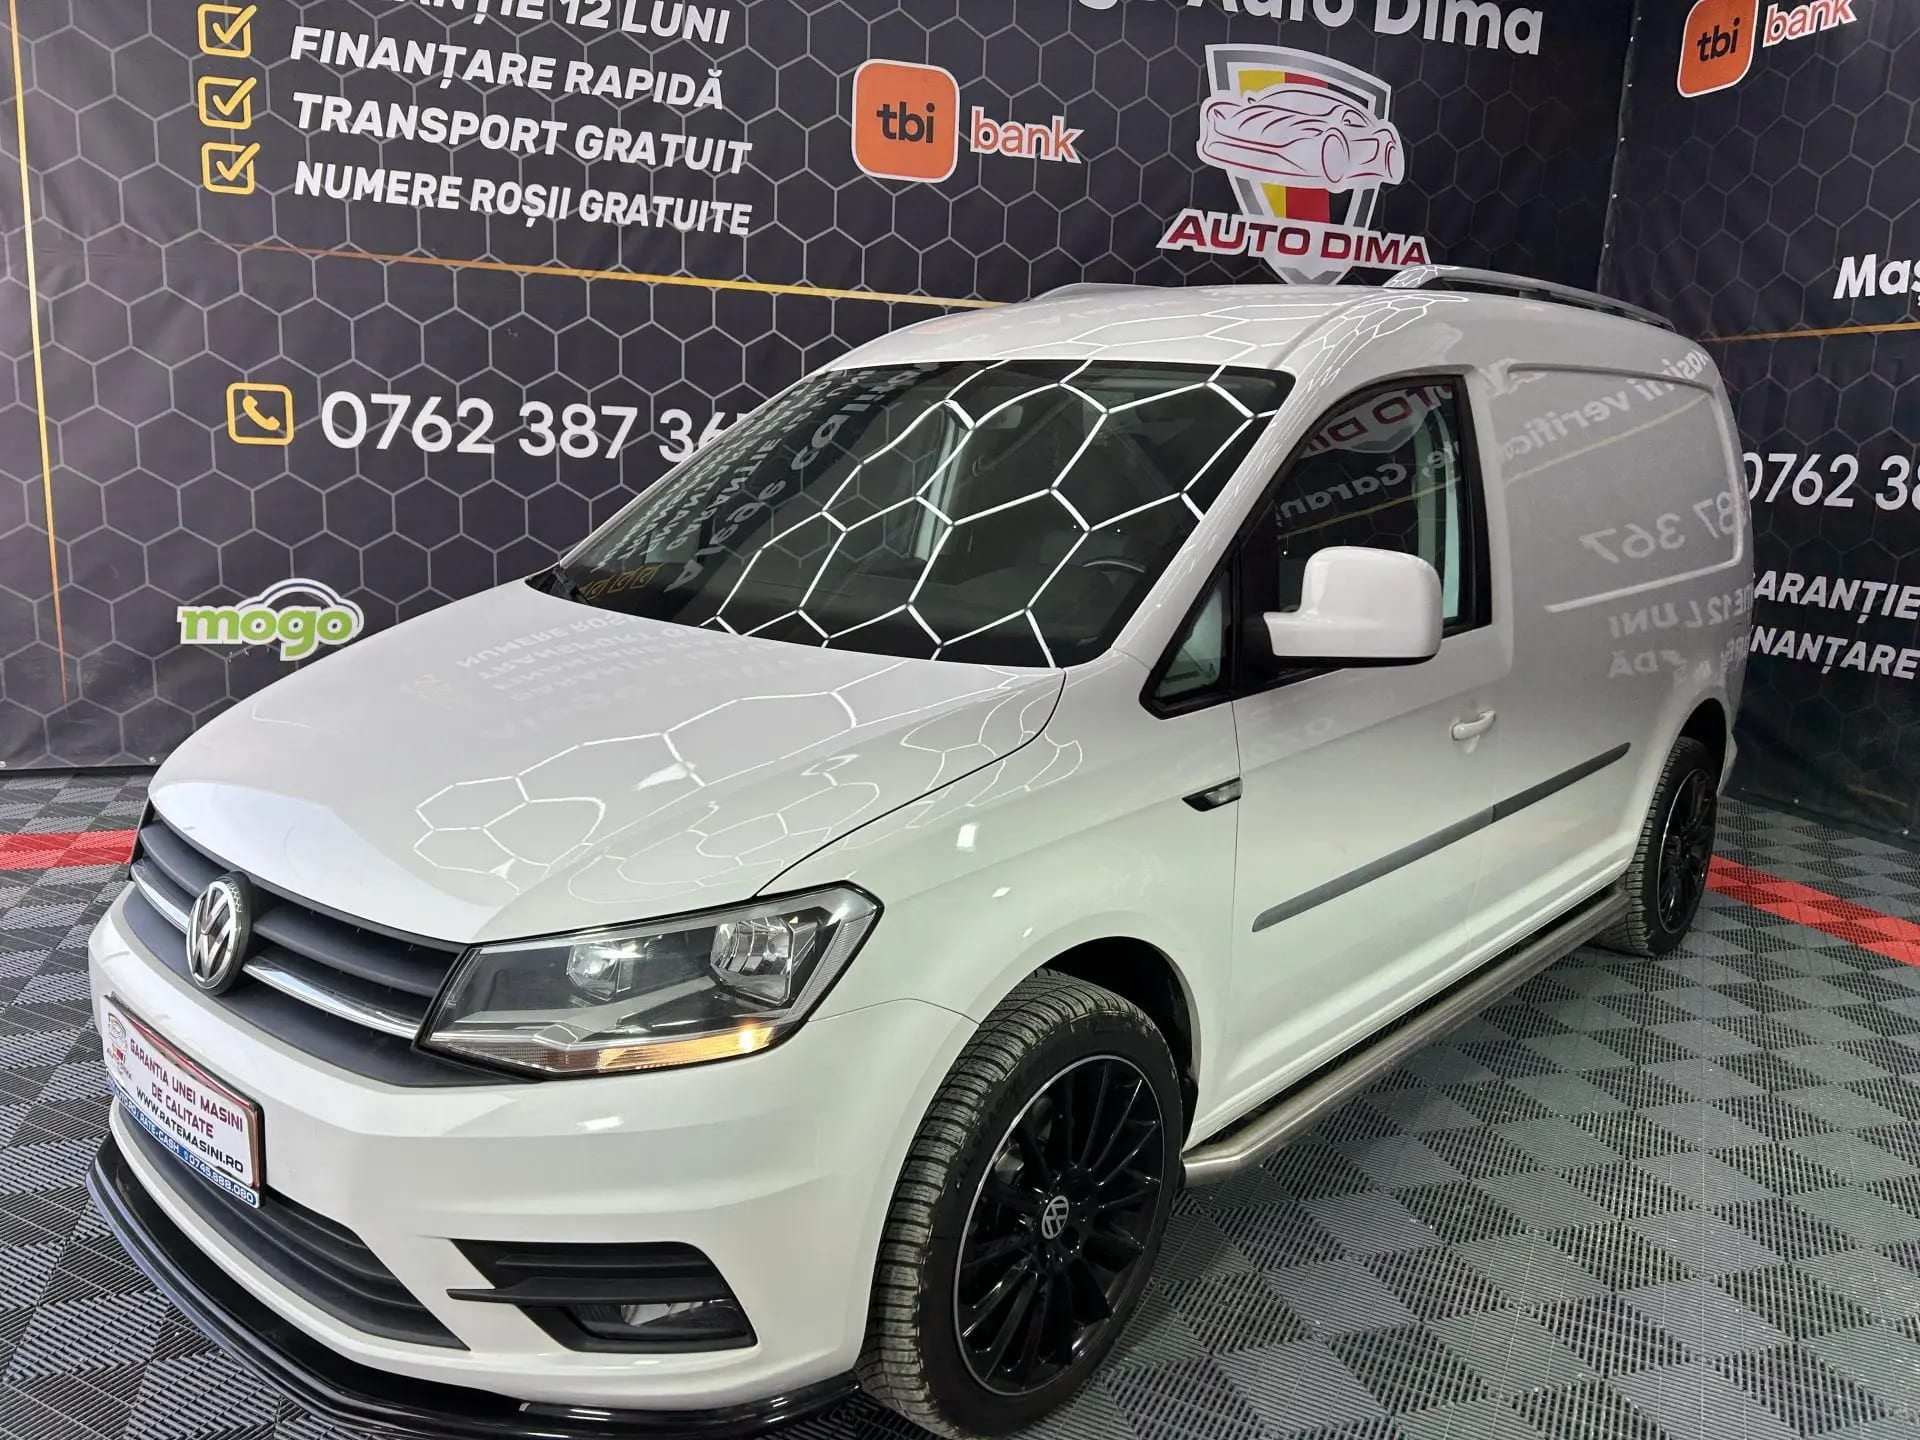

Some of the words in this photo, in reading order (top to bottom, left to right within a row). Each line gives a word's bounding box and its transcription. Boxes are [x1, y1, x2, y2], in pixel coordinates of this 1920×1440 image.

[620, 0, 731, 45] LUNI
[1374, 0, 1543, 55] Dima
[1697, 17, 1741, 62] tbi
[1764, 0, 1856, 46] bank
[289, 26, 557, 90] FINANȚARE
[564, 60, 725, 110] RAPIDĂ
[293, 92, 568, 156] TRANSPORT
[574, 124, 753, 175] GRATUIT
[876, 101, 937, 144] tbi
[972, 108, 1080, 162] bank
[294, 160, 463, 210] NUMERE
[469, 177, 571, 228] ROȘII
[579, 189, 754, 236] GRATUITE
[1167, 214, 1310, 257] AUTO
[1319, 231, 1427, 266] DIMA
[321, 390, 496, 455] 0762
[518, 400, 639, 460] 387
[658, 408, 750, 463] 36
[1742, 452, 1861, 508] 0762
[1875, 454, 1920, 511] 3
[1752, 569, 1920, 625] ARANȚIE
[180, 607, 354, 658] mogo
[1750, 624, 1920, 681] NANȚARE
[130, 1038, 169, 1086] GARANTIA
[172, 1076, 196, 1104] UNEI
[200, 1095, 244, 1133] MASINI
[151, 1082, 163, 1104] DE
[165, 1095, 214, 1139] CALITATE
[136, 1085, 244, 1174] WWW.RATEMASINI.RO
